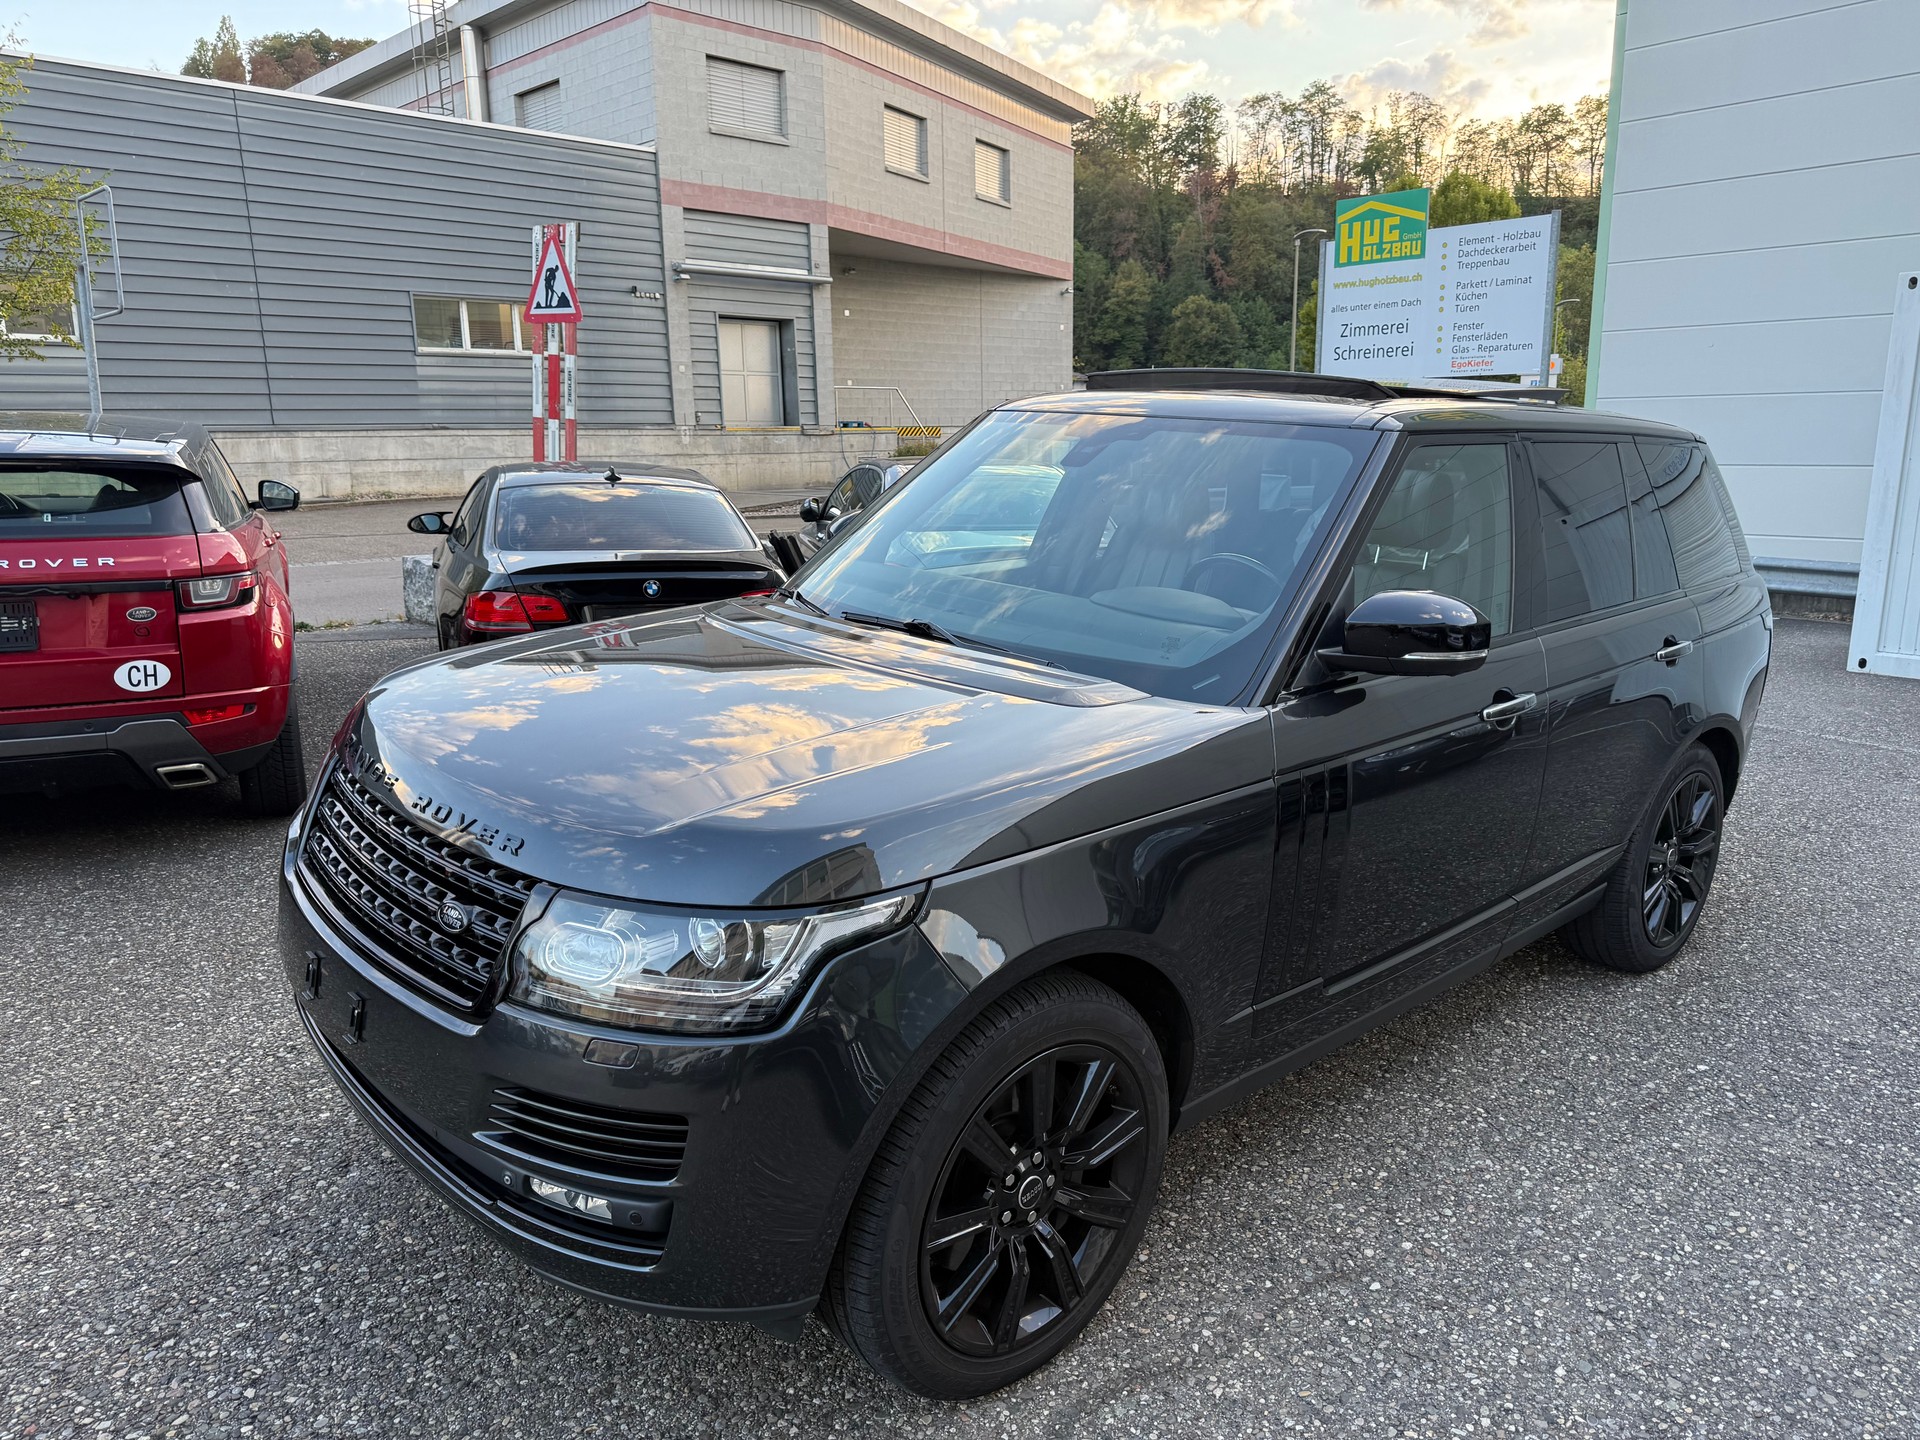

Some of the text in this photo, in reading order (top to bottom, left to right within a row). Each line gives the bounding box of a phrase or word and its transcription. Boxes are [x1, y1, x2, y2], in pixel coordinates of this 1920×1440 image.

[1339, 216, 1400, 264] HUG
[1402, 232, 1422, 240] GmbH
[1458, 235, 1495, 247] Element
[1503, 230, 1541, 241] Holzbau
[1457, 241, 1536, 258] Dachdeckerarbeit
[1457, 257, 1510, 270] Treppenbau
[1333, 272, 1422, 289] www.hugholzbau.ch
[1456, 279, 1488, 290] Parkett
[1495, 275, 1532, 287] Laminat
[1455, 291, 1488, 301] Küchen
[1331, 298, 1422, 313] alles unter einem Dach
[1455, 303, 1480, 313] Türen
[1340, 318, 1409, 338] Zimmerei
[1453, 322, 1485, 331] Fenster
[1452, 332, 1508, 343] Fensterläden
[1333, 341, 1414, 360] Schreinerei
[1451, 345, 1470, 354] Glas
[1477, 342, 1533, 354] Reparaturen
[1451, 359, 1494, 369] EgoKiefer
[0, 557, 116, 569] ROVER
[127, 664, 158, 687] CH
[411, 792, 525, 857] ROVER
[443, 905, 461, 918] LAND
[442, 914, 462, 929] ROVER
